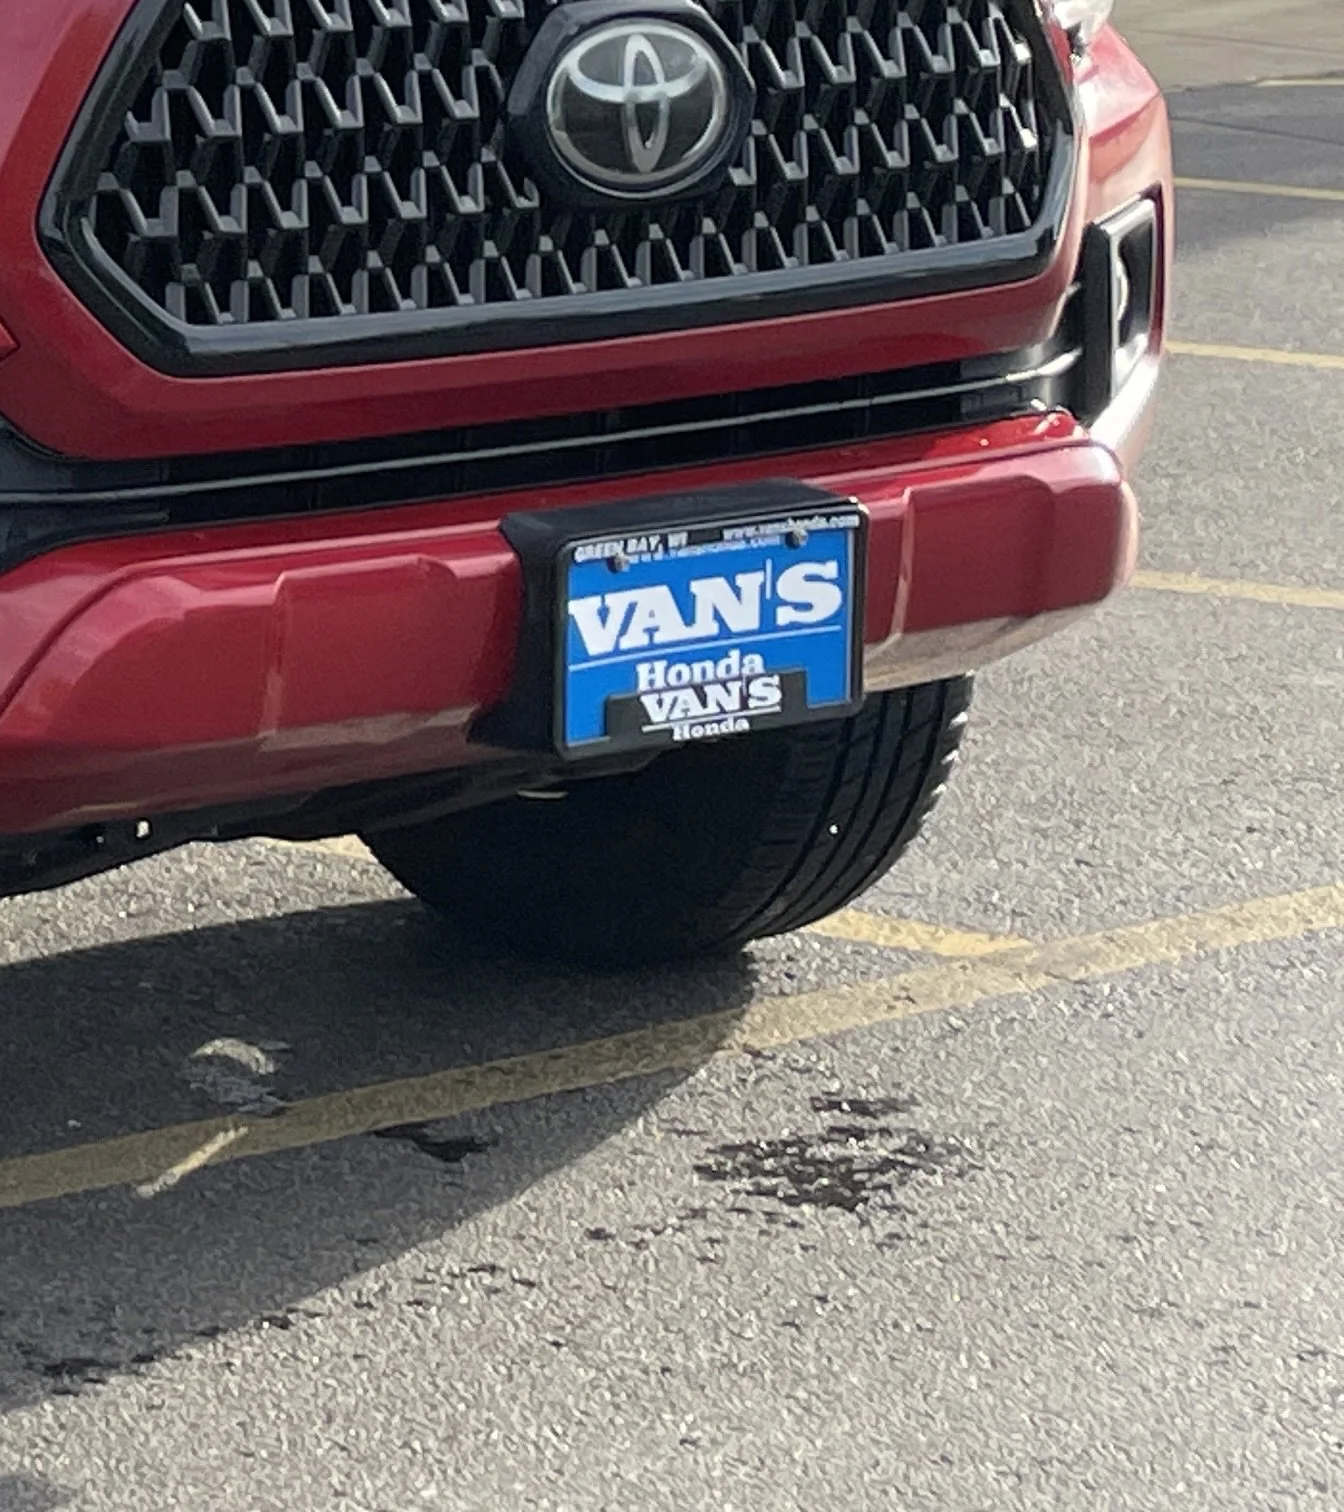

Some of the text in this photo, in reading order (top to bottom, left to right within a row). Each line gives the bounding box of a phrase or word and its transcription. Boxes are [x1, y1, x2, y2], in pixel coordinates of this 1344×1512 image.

[568, 558, 843, 656] VAN'S
[636, 648, 765, 692] Honda
[640, 674, 783, 723] VAN'S
[672, 717, 751, 741] Honda
